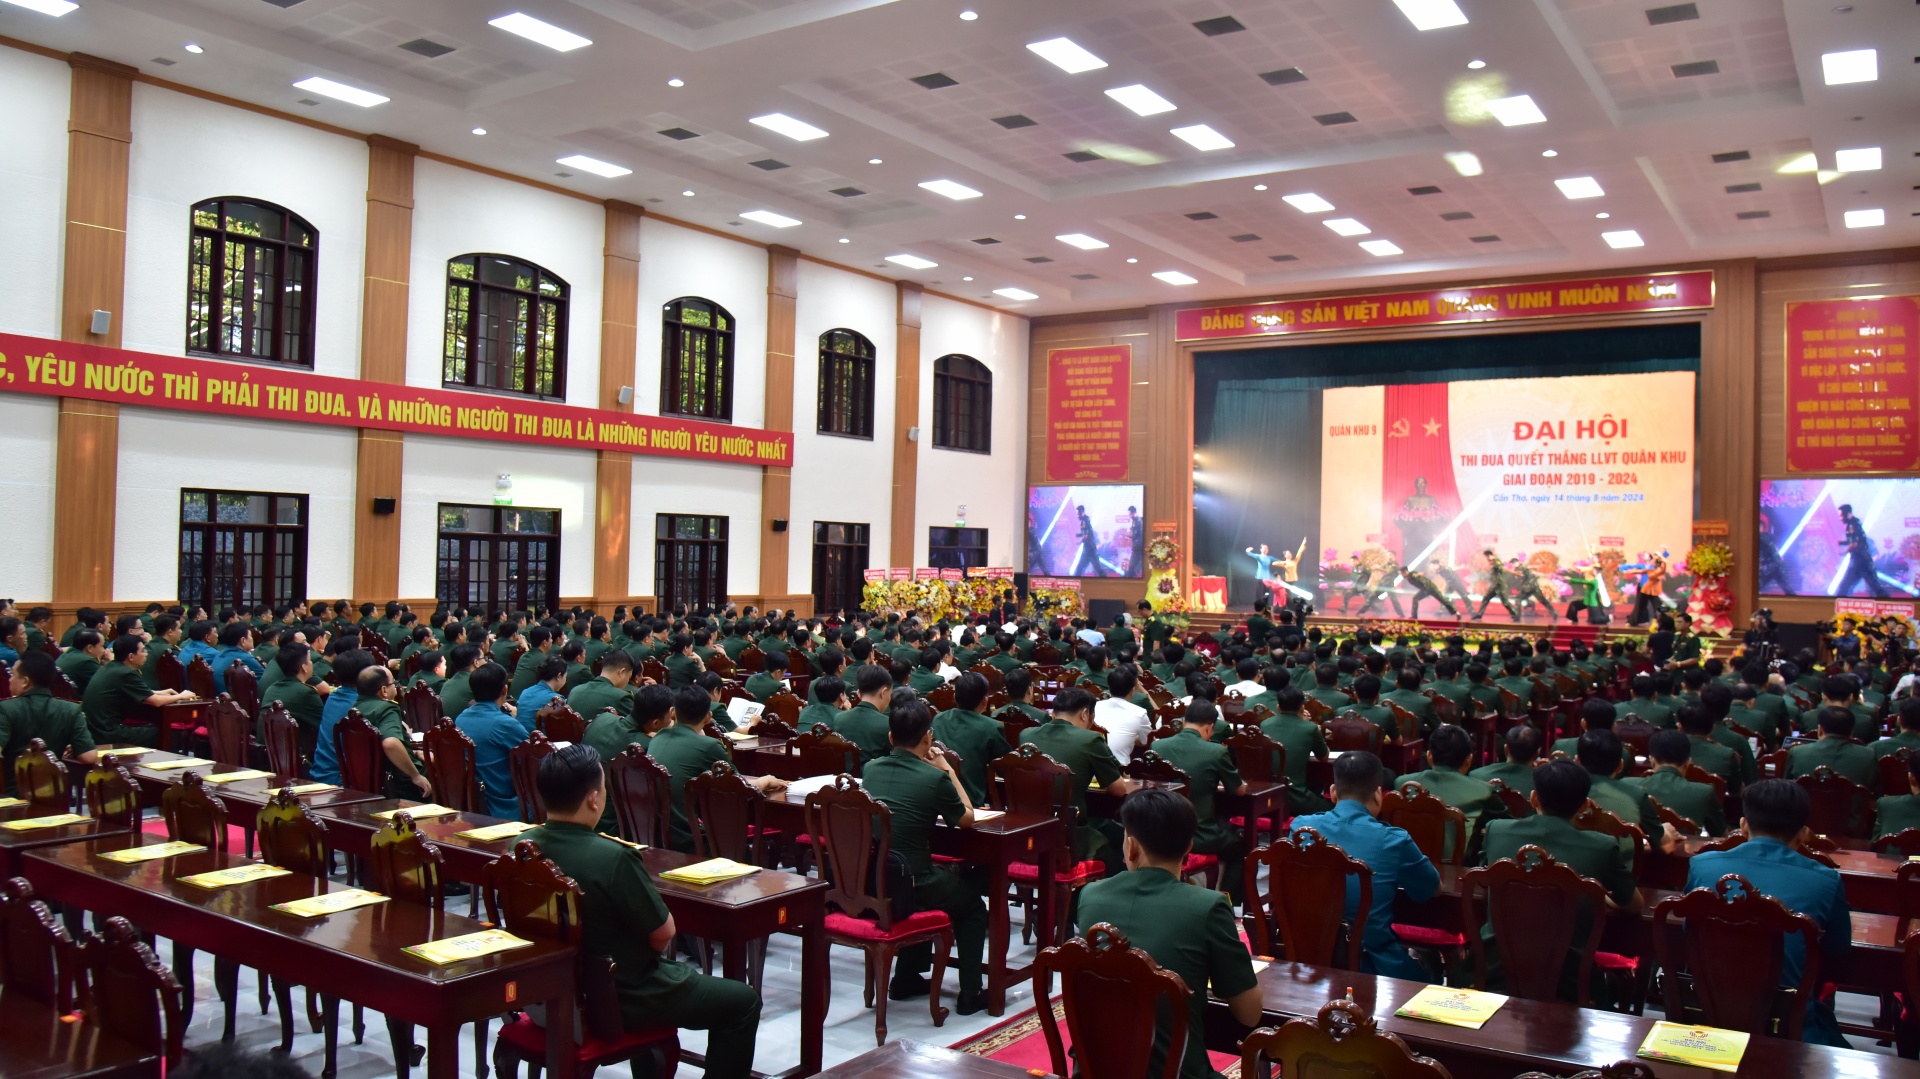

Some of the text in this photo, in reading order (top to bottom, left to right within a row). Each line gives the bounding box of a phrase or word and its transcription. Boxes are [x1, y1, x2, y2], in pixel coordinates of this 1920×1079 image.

[1200, 309, 1245, 331] ĐẢNG
[1301, 301, 1338, 325] SẢN
[1343, 301, 1380, 324] VIỆT
[1386, 300, 1430, 319] NAM
[1506, 291, 1553, 310] VINH
[1559, 284, 1619, 307] MUÔN
[25, 352, 76, 387] YÊU
[84, 361, 155, 396] NƯỚC
[163, 372, 199, 402] THÌ
[206, 371, 259, 408] PHẢI
[266, 385, 299, 412] THI
[304, 389, 352, 418] ĐUA.
[357, 393, 383, 421] VÀ
[388, 400, 452, 428] NHỮNG
[456, 407, 510, 433] NGƯỜI
[513, 413, 539, 437] THI
[542, 415, 573, 440] ĐUA
[577, 417, 595, 442] LÀ
[599, 421, 647, 448] NHỮNG
[651, 426, 692, 451] NGƯỜI
[695, 429, 718, 454] YÊU
[721, 432, 755, 457] NƯỚC
[757, 434, 787, 461] NHẤT
[1329, 423, 1377, 438] QUÂN KHU 9
[1511, 413, 1628, 448] ĐẠI HỘI
[1460, 448, 1687, 468] THI ĐUA QUYẾT THẮNG LLVT QUÂN KHU
[1503, 472, 1527, 487] GIAI
[1529, 472, 1563, 490] ĐOẠN
[1566, 472, 1596, 486] 2019
[1607, 471, 1639, 486] 2024
[1554, 493, 1565, 502] 14
[1622, 493, 1645, 502] 2024
